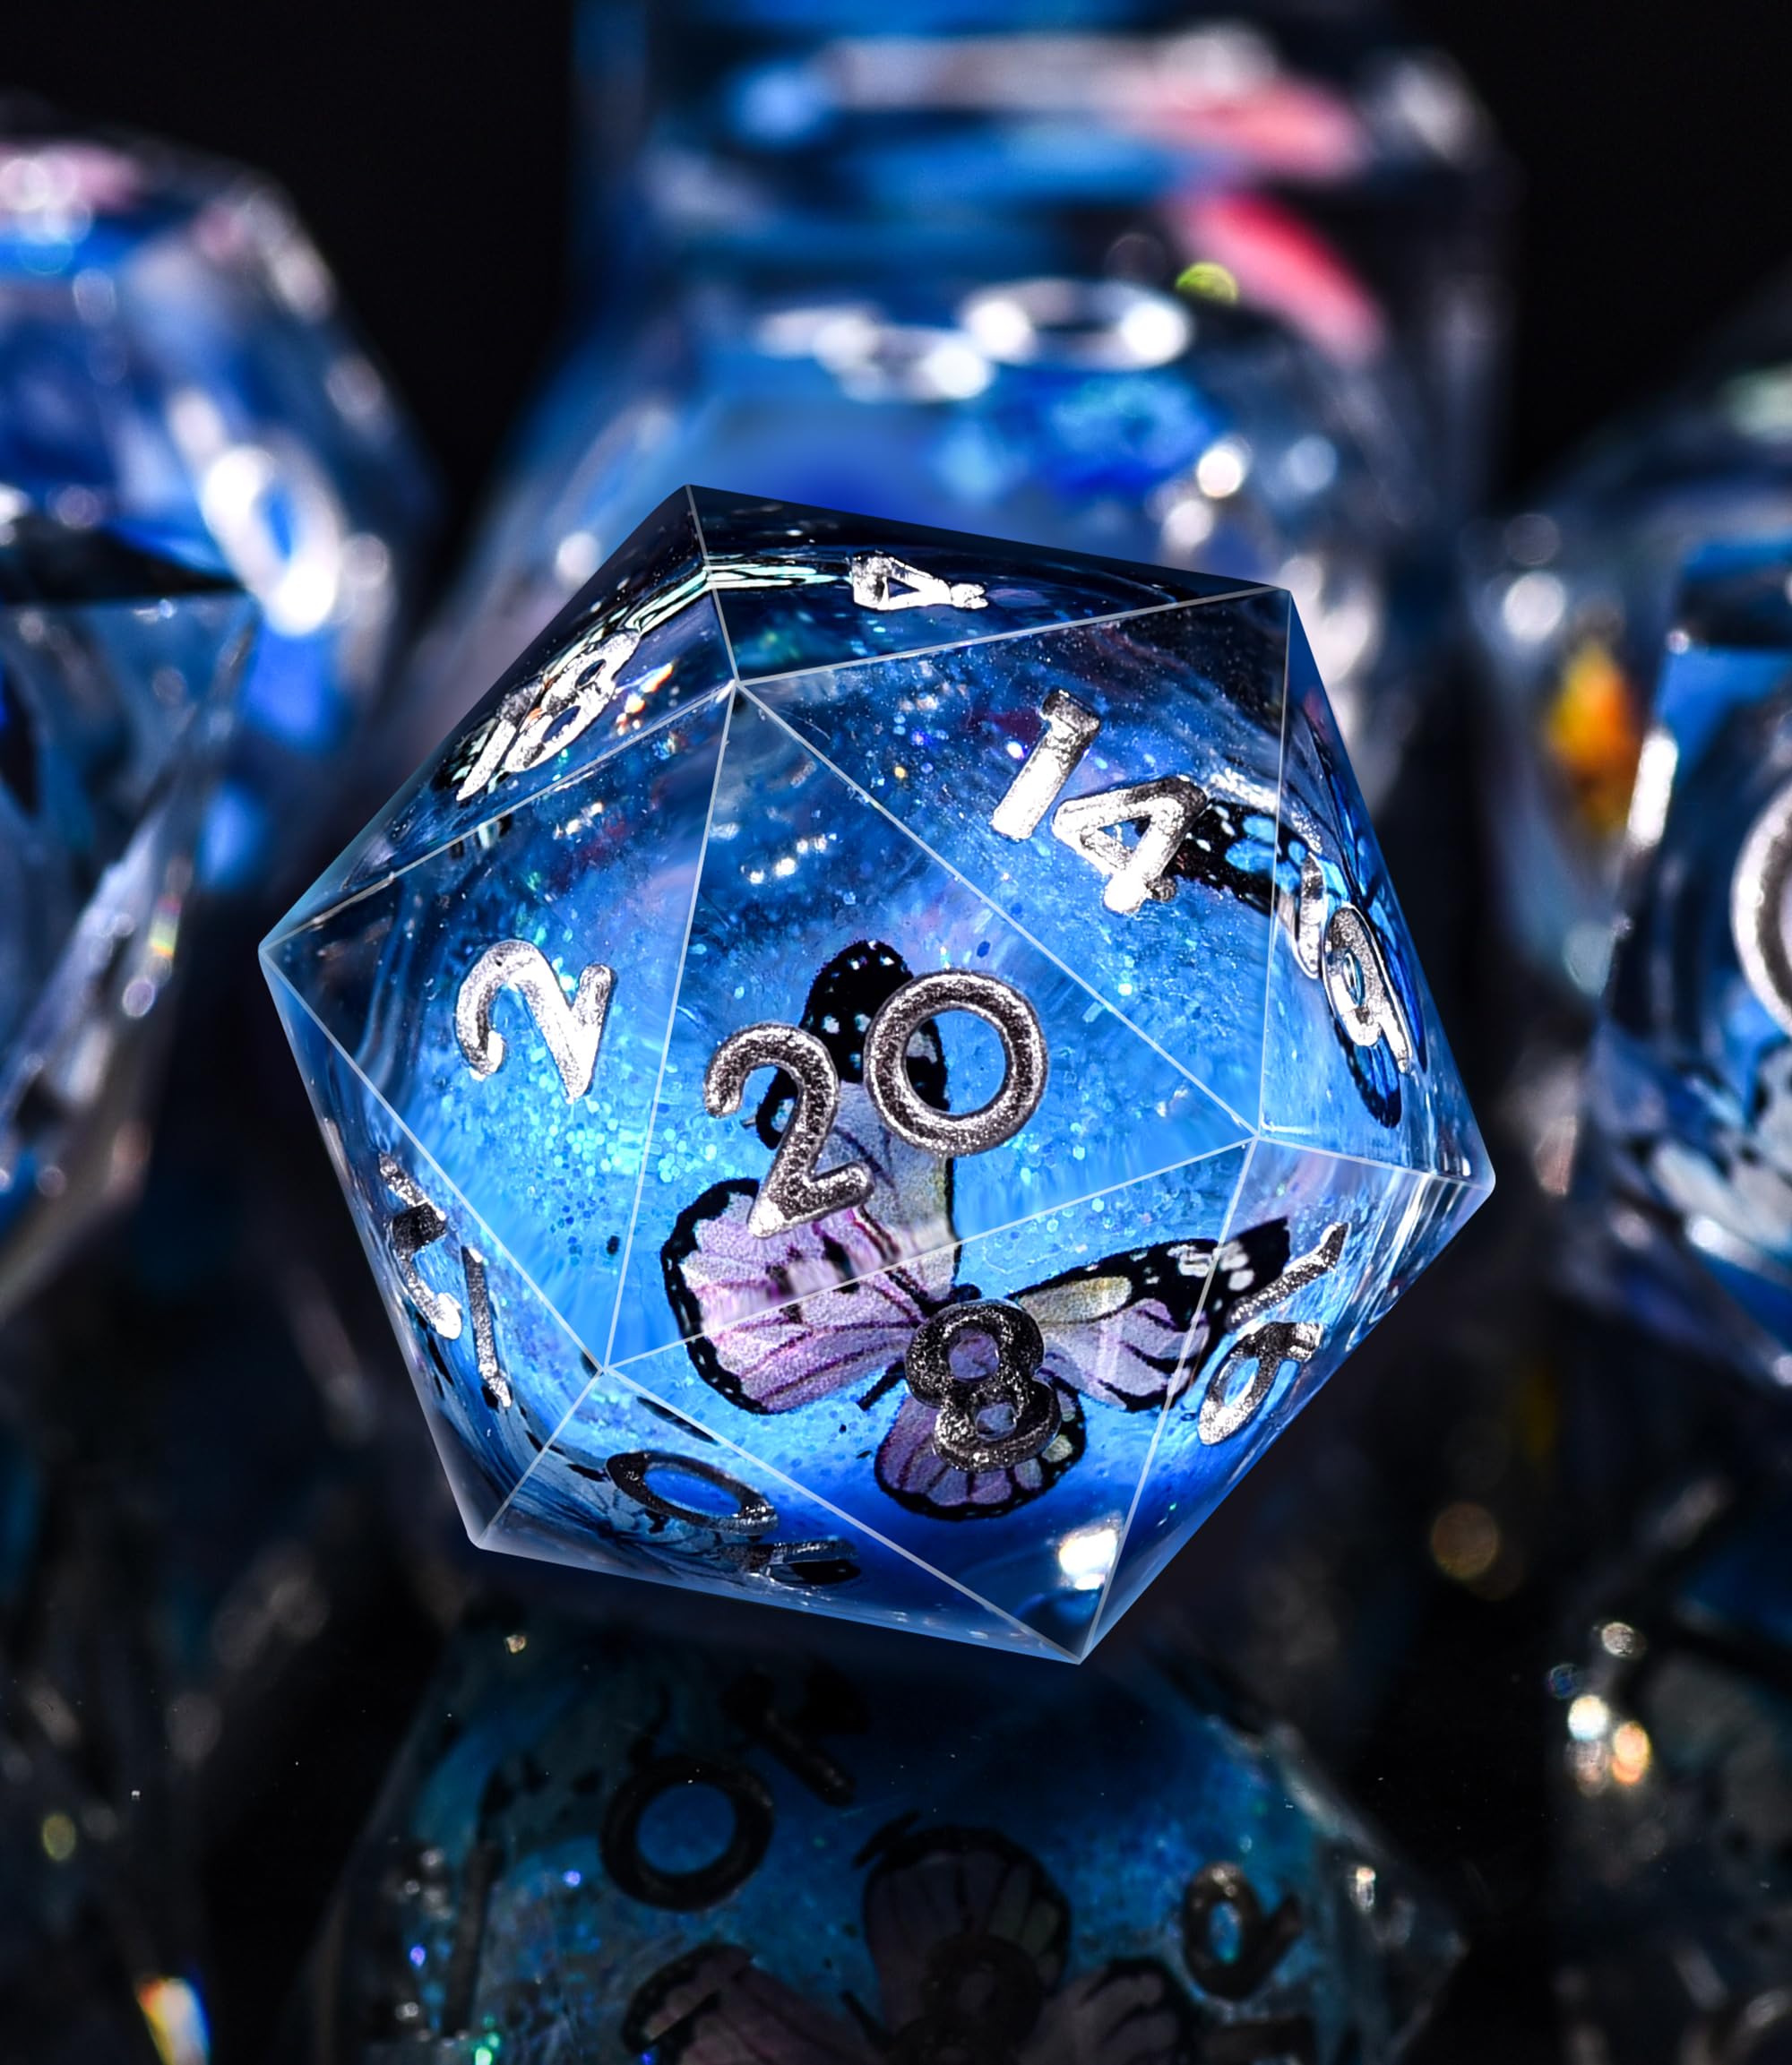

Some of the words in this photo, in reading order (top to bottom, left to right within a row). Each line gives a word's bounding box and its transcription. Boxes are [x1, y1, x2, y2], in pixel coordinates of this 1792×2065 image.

[992, 688, 1209, 915] 14
[455, 939, 616, 1103] 2
[703, 968, 1048, 1238] 20
[905, 1299, 1061, 1472] 8
[1198, 1221, 1349, 1445] 16
